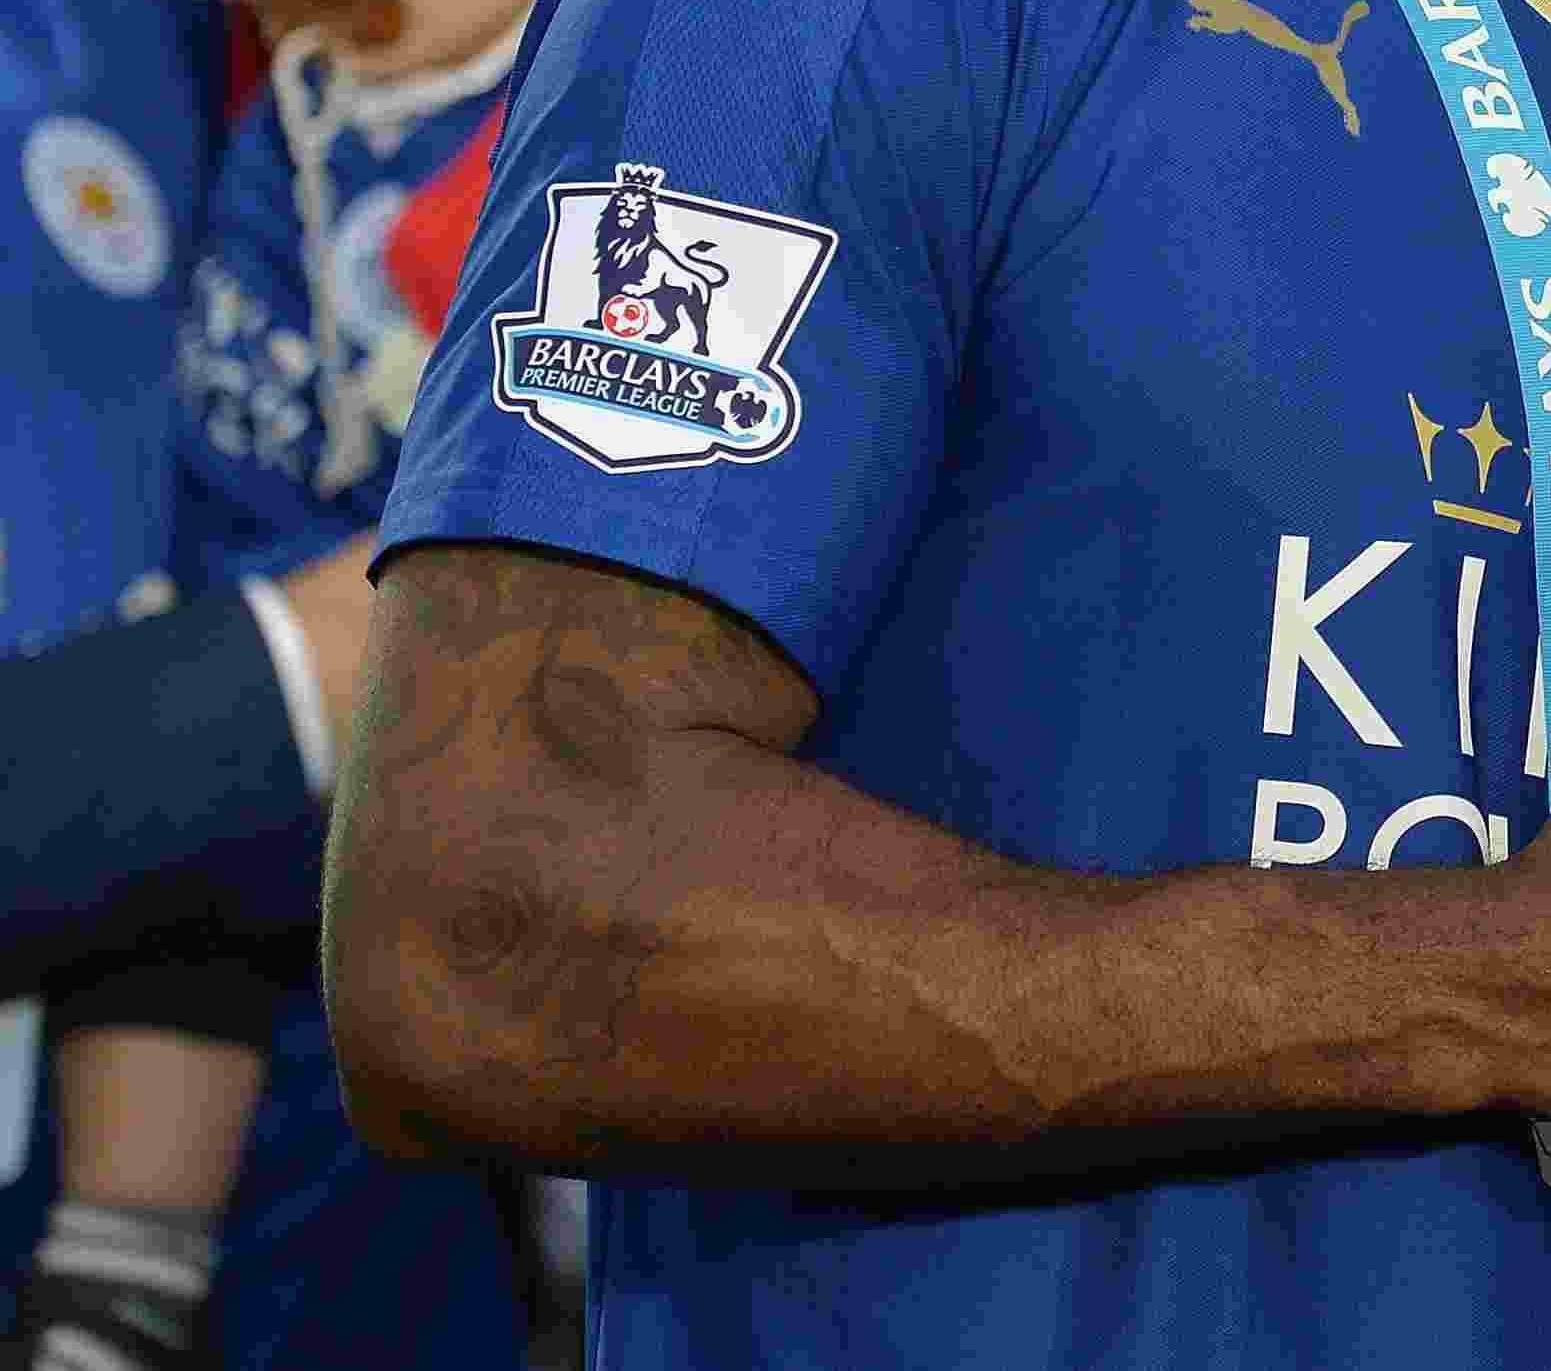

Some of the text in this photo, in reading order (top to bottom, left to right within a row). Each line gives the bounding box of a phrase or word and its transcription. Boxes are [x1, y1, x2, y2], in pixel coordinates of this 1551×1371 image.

[520, 367, 704, 421] PREMIER LEAGUE
[527, 338, 711, 400] BARCLAYS
